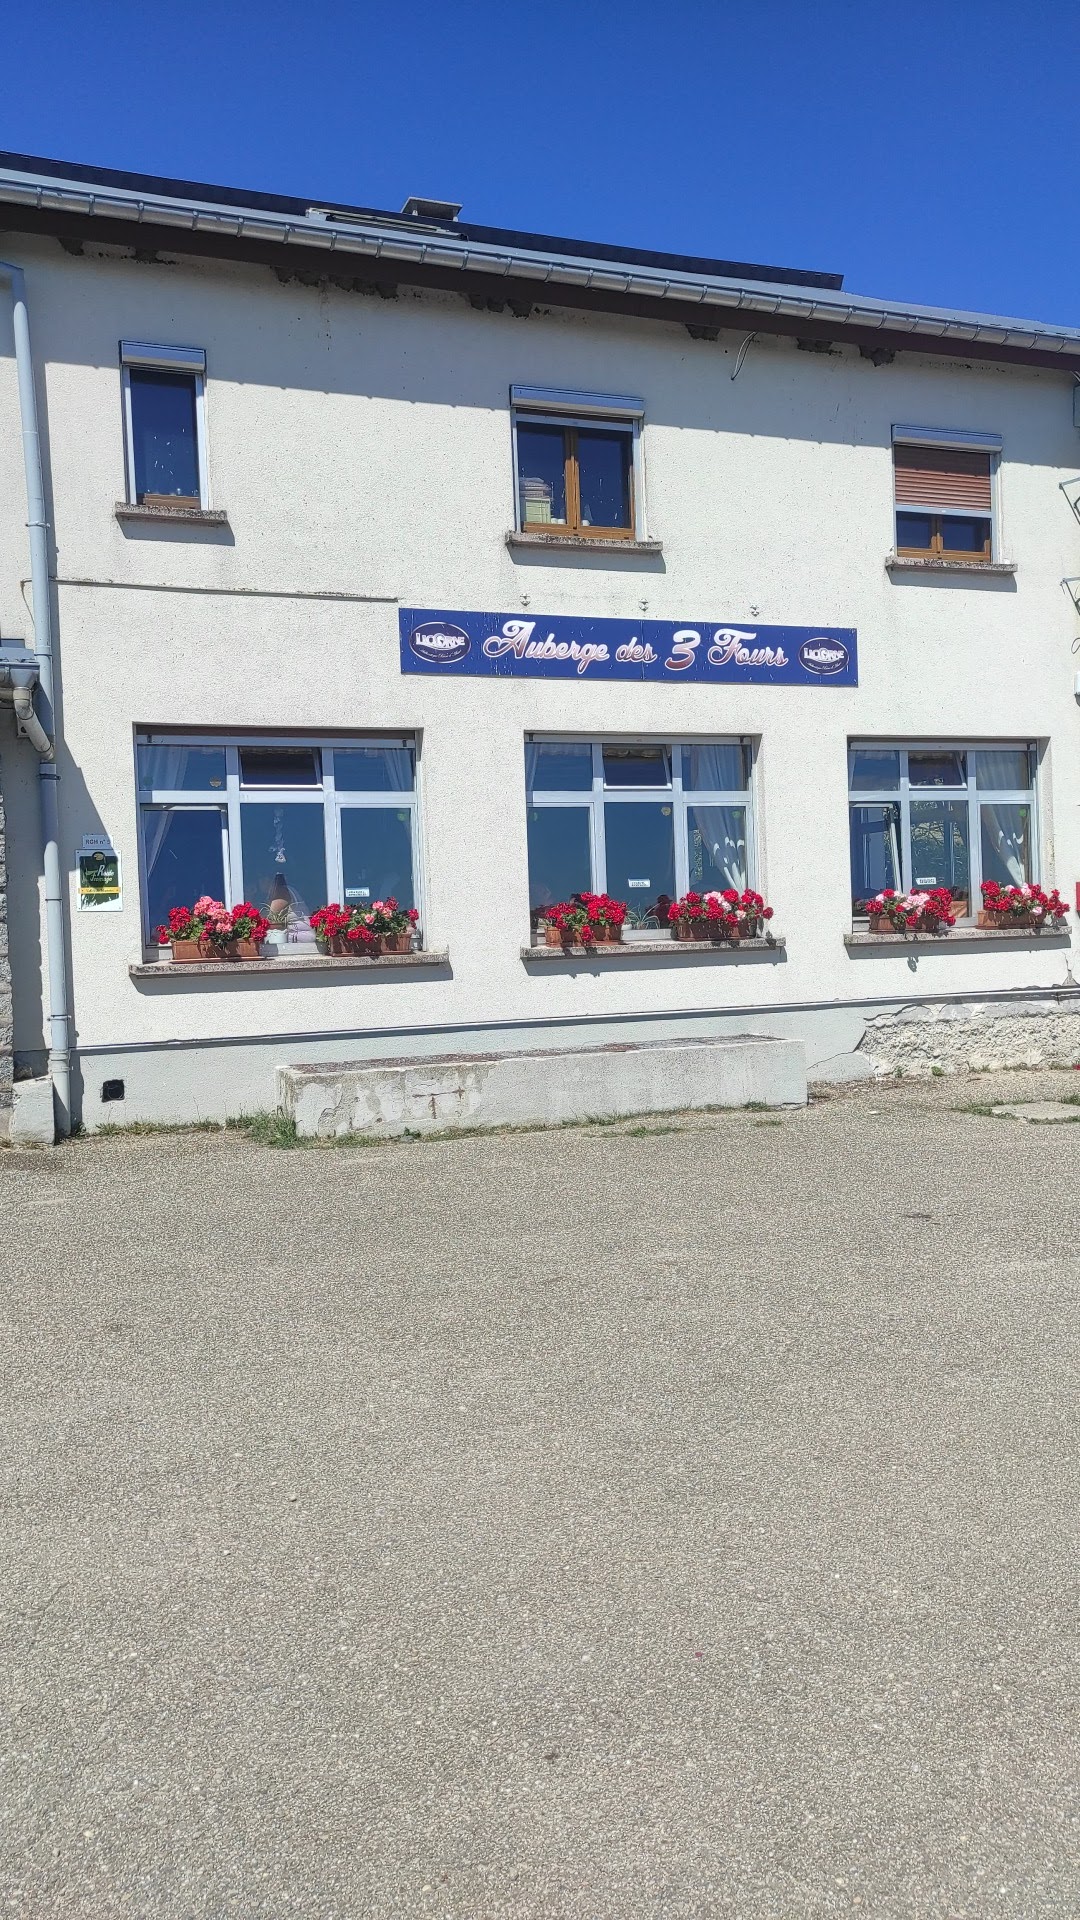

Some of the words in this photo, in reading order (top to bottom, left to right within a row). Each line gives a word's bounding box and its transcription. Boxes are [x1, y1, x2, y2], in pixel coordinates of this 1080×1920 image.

[483, 620, 610, 675] Auberge
[615, 636, 657, 663] des
[664, 629, 701, 671] 3
[707, 628, 789, 667] Fours
